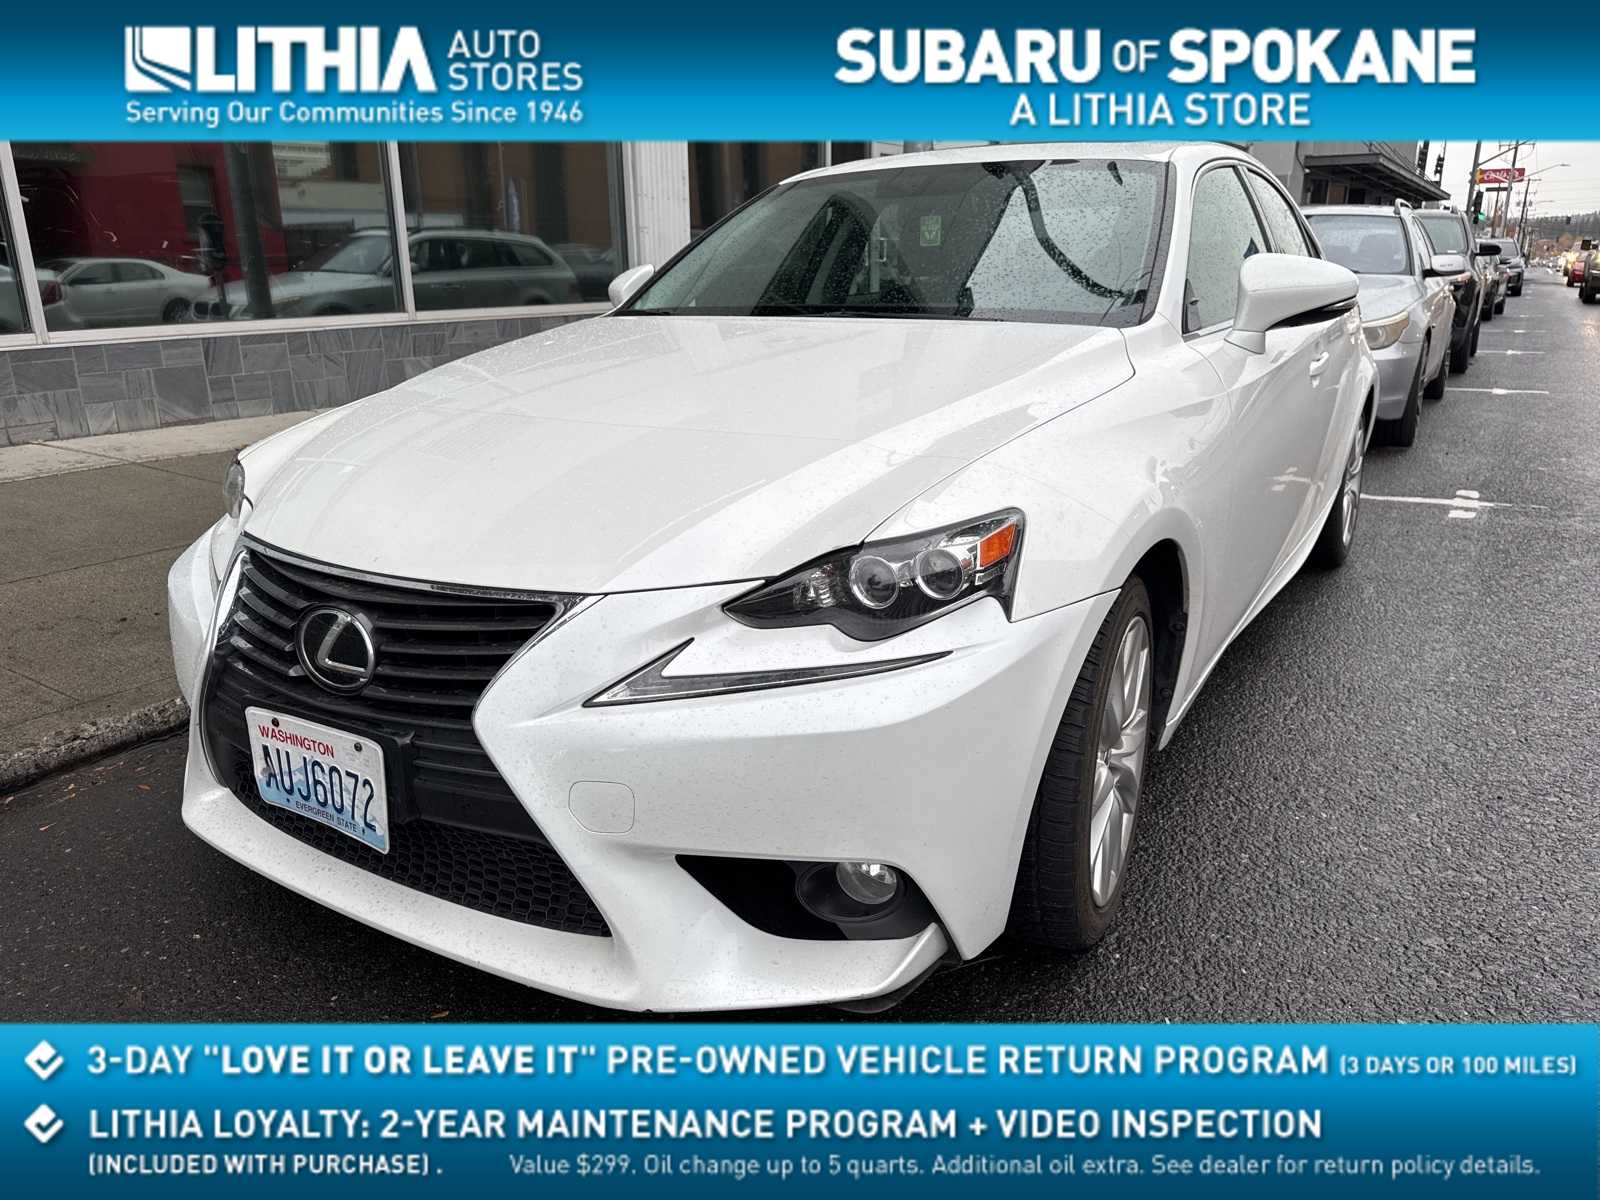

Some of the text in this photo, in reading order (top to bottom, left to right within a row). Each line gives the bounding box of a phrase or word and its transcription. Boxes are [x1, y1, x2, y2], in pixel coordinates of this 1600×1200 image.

[258, 724, 335, 758] WASHINGTON
[261, 743, 377, 833] AUJ6072
[295, 800, 358, 833] EVERGREEN STATE
